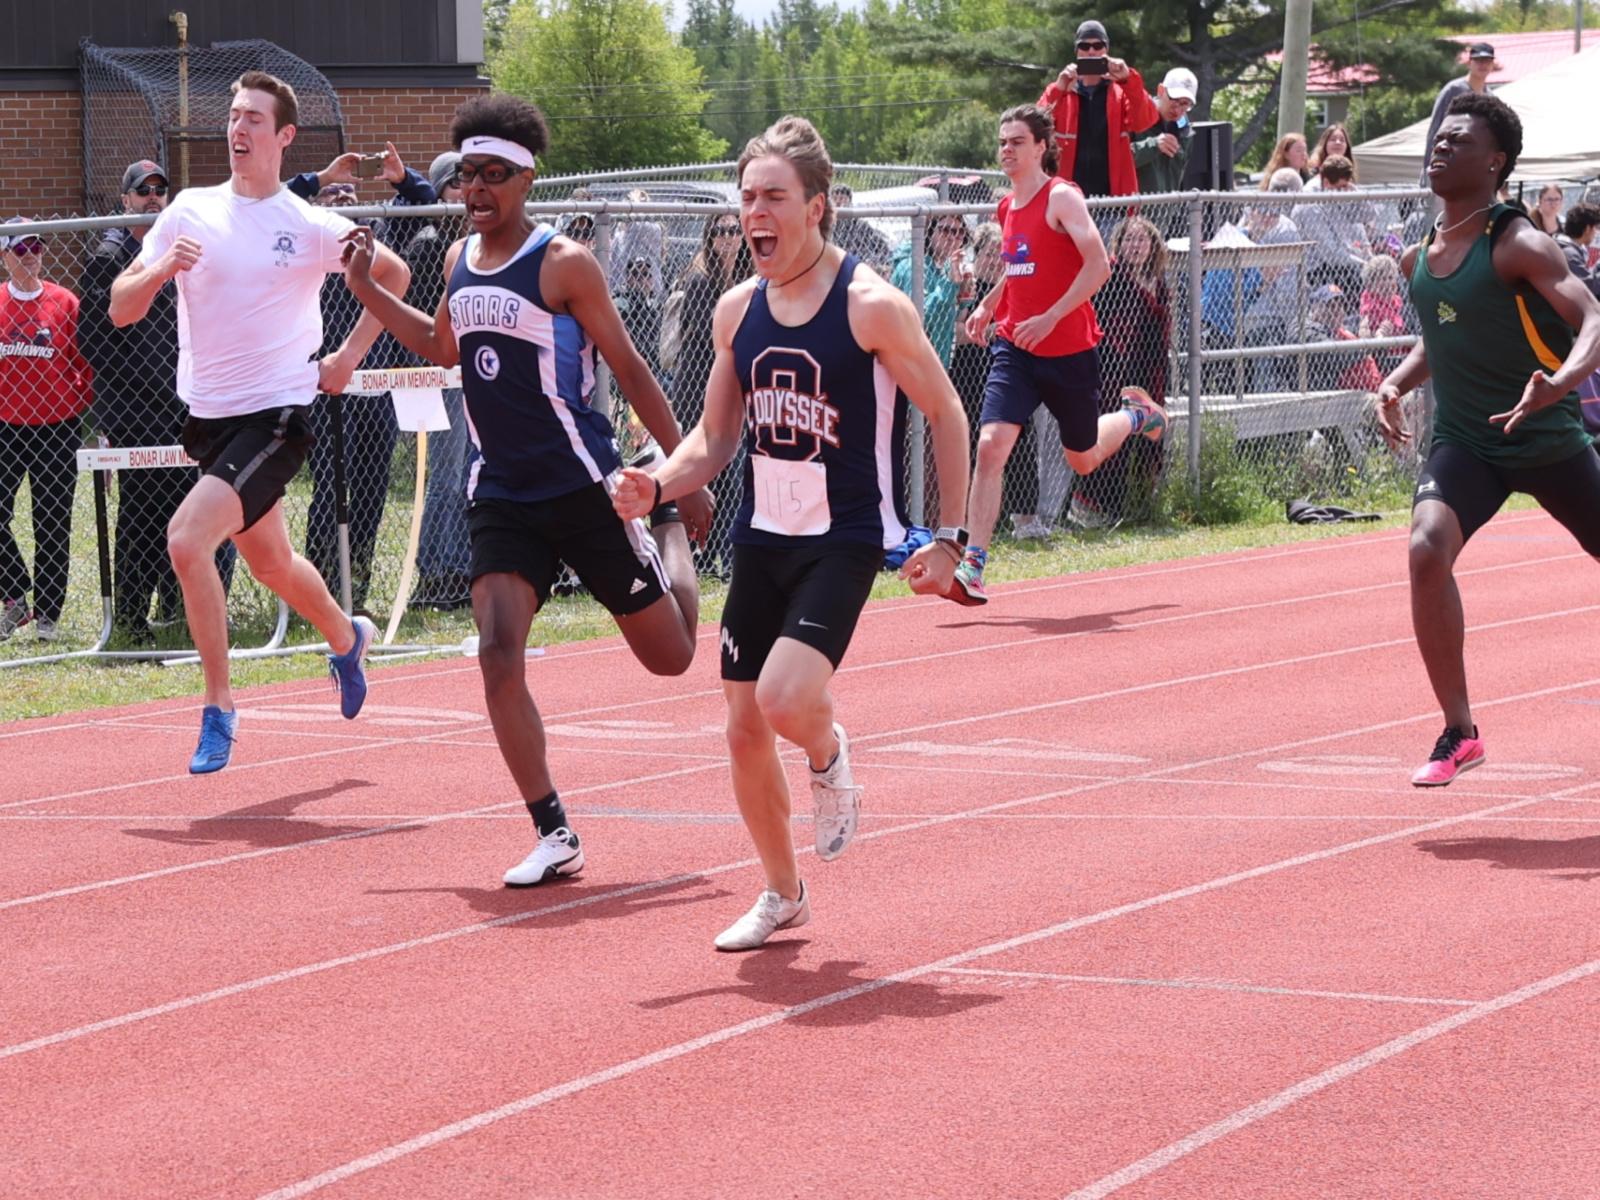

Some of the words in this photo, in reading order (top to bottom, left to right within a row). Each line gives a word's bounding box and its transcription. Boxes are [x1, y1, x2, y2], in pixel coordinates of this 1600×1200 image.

[451, 294, 521, 331] STARS
[361, 373, 389, 390] BONAR
[389, 372, 406, 389] LAW
[407, 371, 449, 389] MEMORIAL
[129, 450, 158, 467] BONAR
[160, 449, 177, 466] LAW
[765, 478, 802, 519] 115
